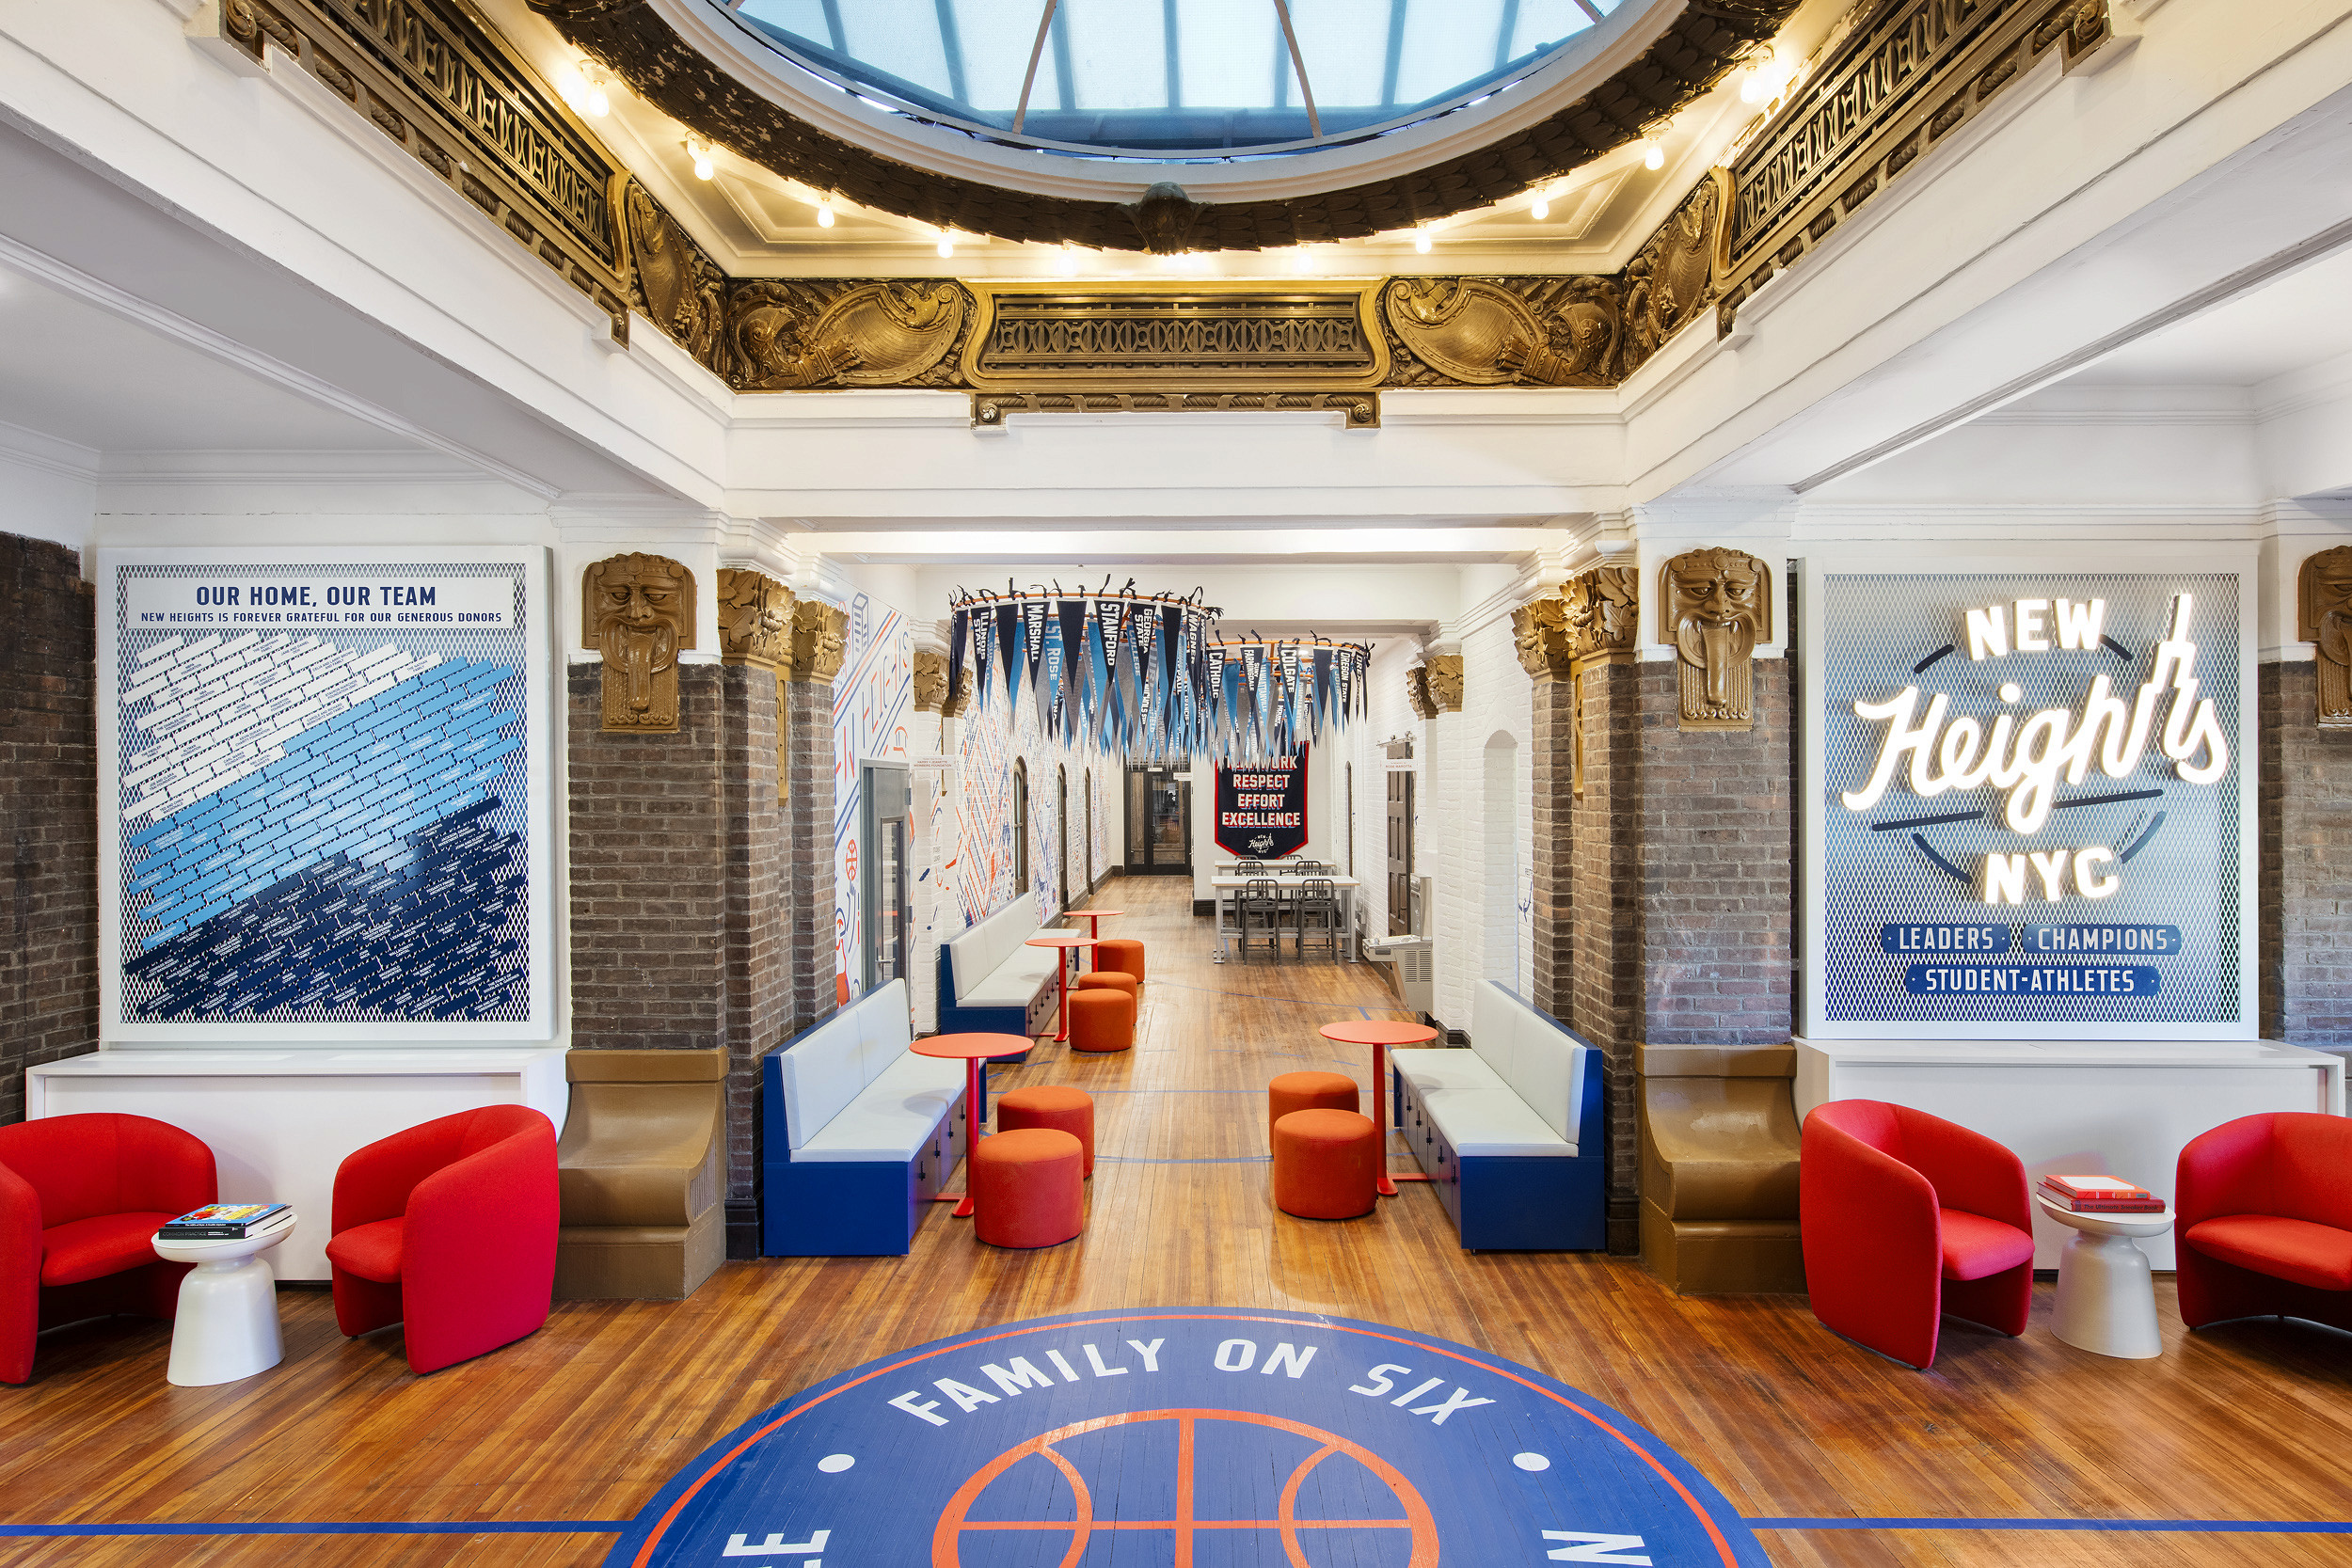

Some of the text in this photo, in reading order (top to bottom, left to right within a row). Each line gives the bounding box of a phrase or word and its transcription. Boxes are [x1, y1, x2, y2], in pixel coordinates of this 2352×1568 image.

[196, 586, 436, 608] OUR HOME, OUR TEAM
[141, 612, 502, 622] NEW HEIGHTS IS FOREVER GRATEFUL FOR OUR GENEROUS DONORS
[1026, 604, 1044, 663] MARSHALL
[1100, 602, 1120, 666] STANFORD
[1135, 613, 1145, 647] STATE
[1143, 608, 1153, 655] GEORGIA
[1963, 598, 2105, 661] NEW
[980, 611, 990, 660] ILLINOIS
[1046, 647, 1061, 681] ROSE
[1208, 652, 1224, 699] CATHOLIC
[1280, 649, 1297, 693] COLGATE
[1340, 652, 1351, 681] OREGON
[1842, 593, 2229, 835] Heights
[1232, 774, 1291, 790] RESPECT
[1238, 794, 1285, 810] EFFORT
[1222, 812, 1301, 828] EXCELLENCE
[1983, 846, 2119, 906] NYC
[1899, 927, 1994, 950] LEADERS
[2038, 928, 2168, 951] CHAMPIONS
[1925, 969, 2135, 992] STUDENT-ATHLETES
[887, 1338, 1497, 1427] FAMILY ON SIX
